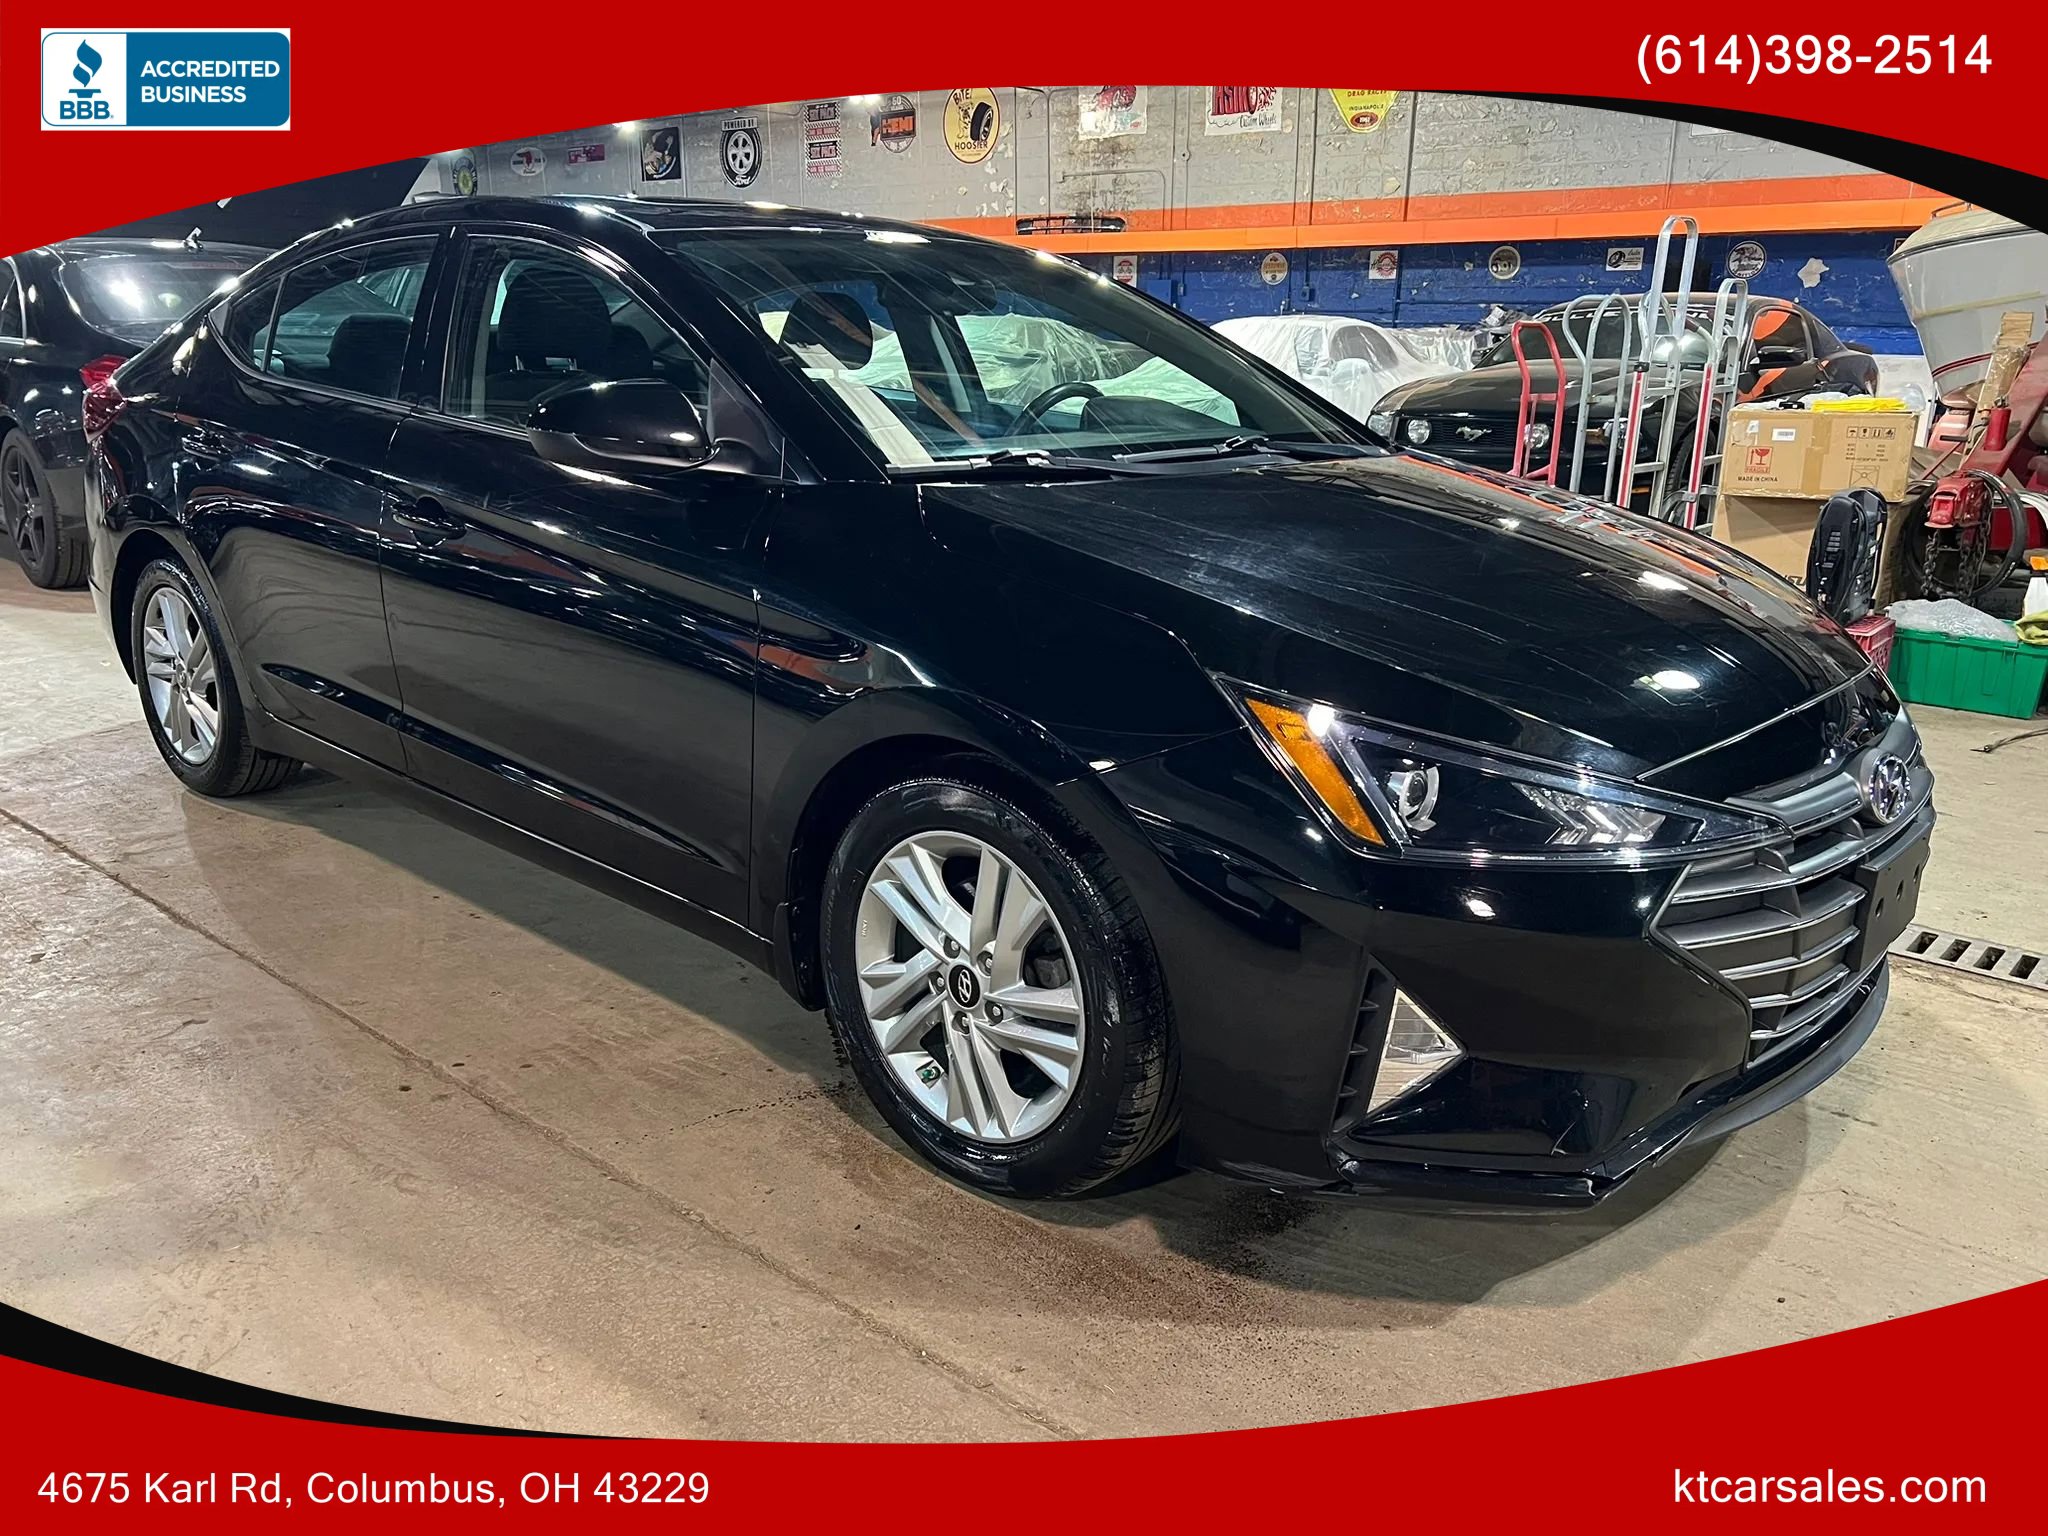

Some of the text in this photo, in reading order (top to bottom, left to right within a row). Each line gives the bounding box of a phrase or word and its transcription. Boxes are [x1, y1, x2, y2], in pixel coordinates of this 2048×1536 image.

[723, 120, 746, 129] POWERED
[882, 115, 914, 134] HEMI
[954, 141, 988, 150] HOOSIER
